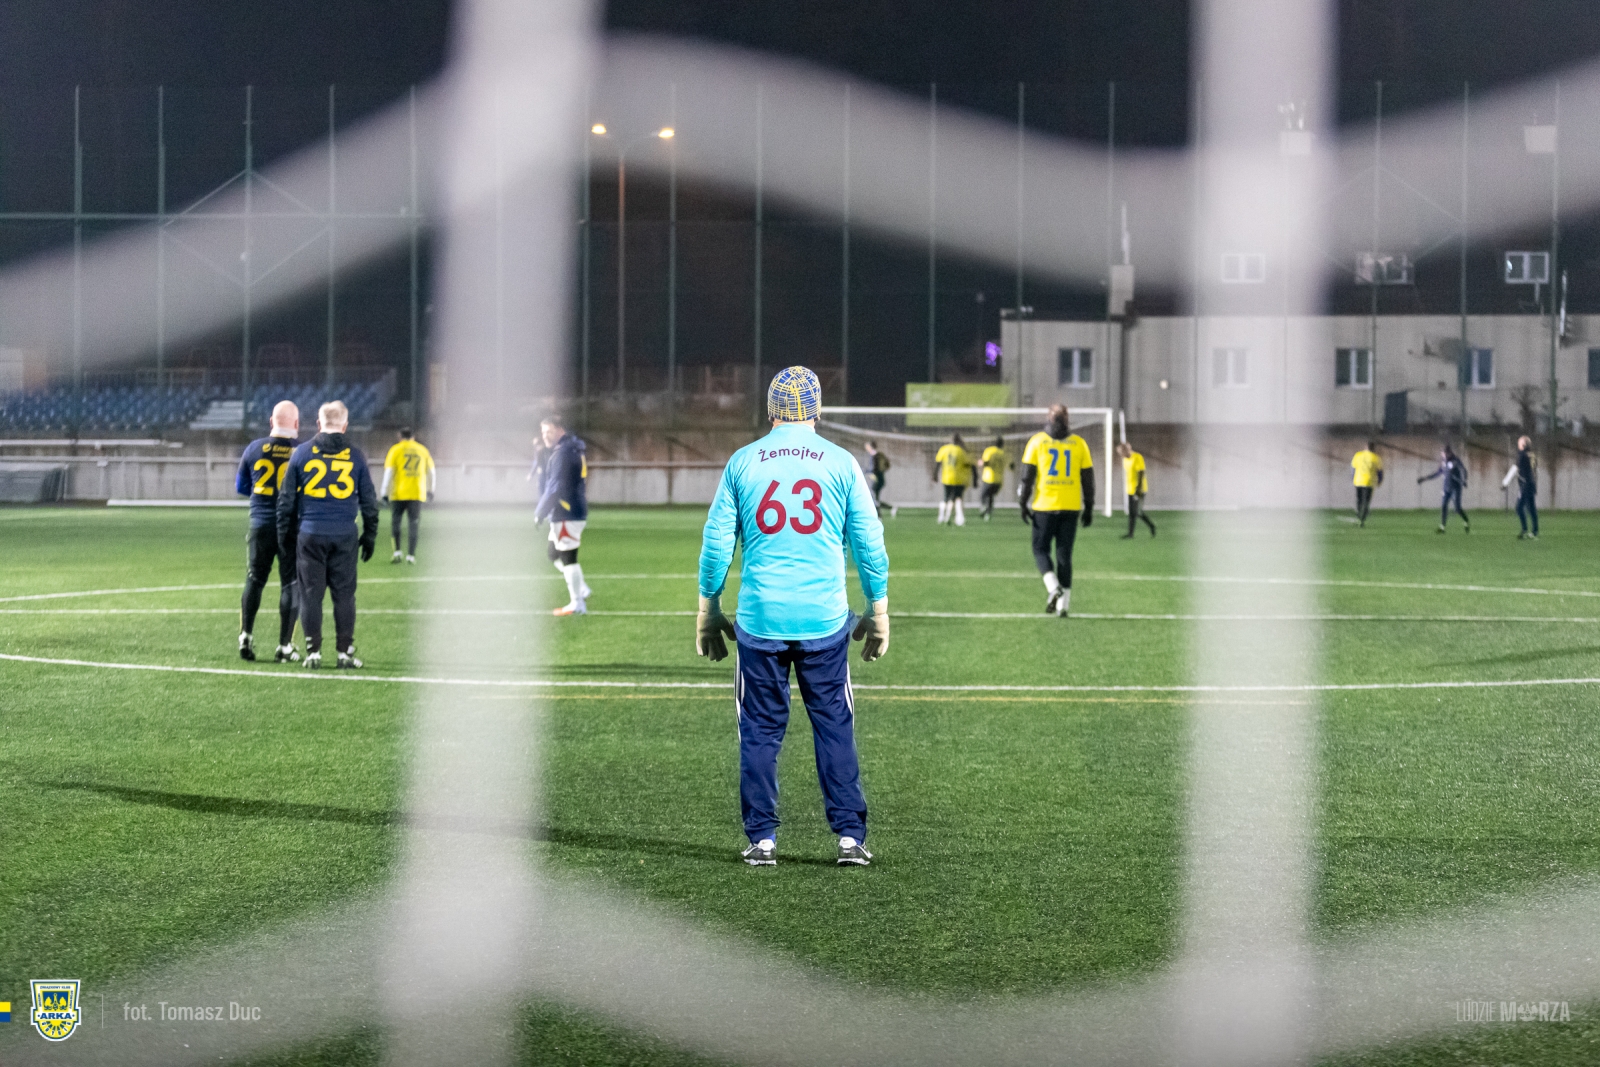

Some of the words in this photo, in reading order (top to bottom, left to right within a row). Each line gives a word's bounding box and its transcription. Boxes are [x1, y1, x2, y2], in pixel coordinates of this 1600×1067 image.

[758, 446, 824, 462] Żemojtel
[1048, 448, 1071, 477] 21
[303, 458, 355, 499] 23
[755, 478, 824, 535] 63
